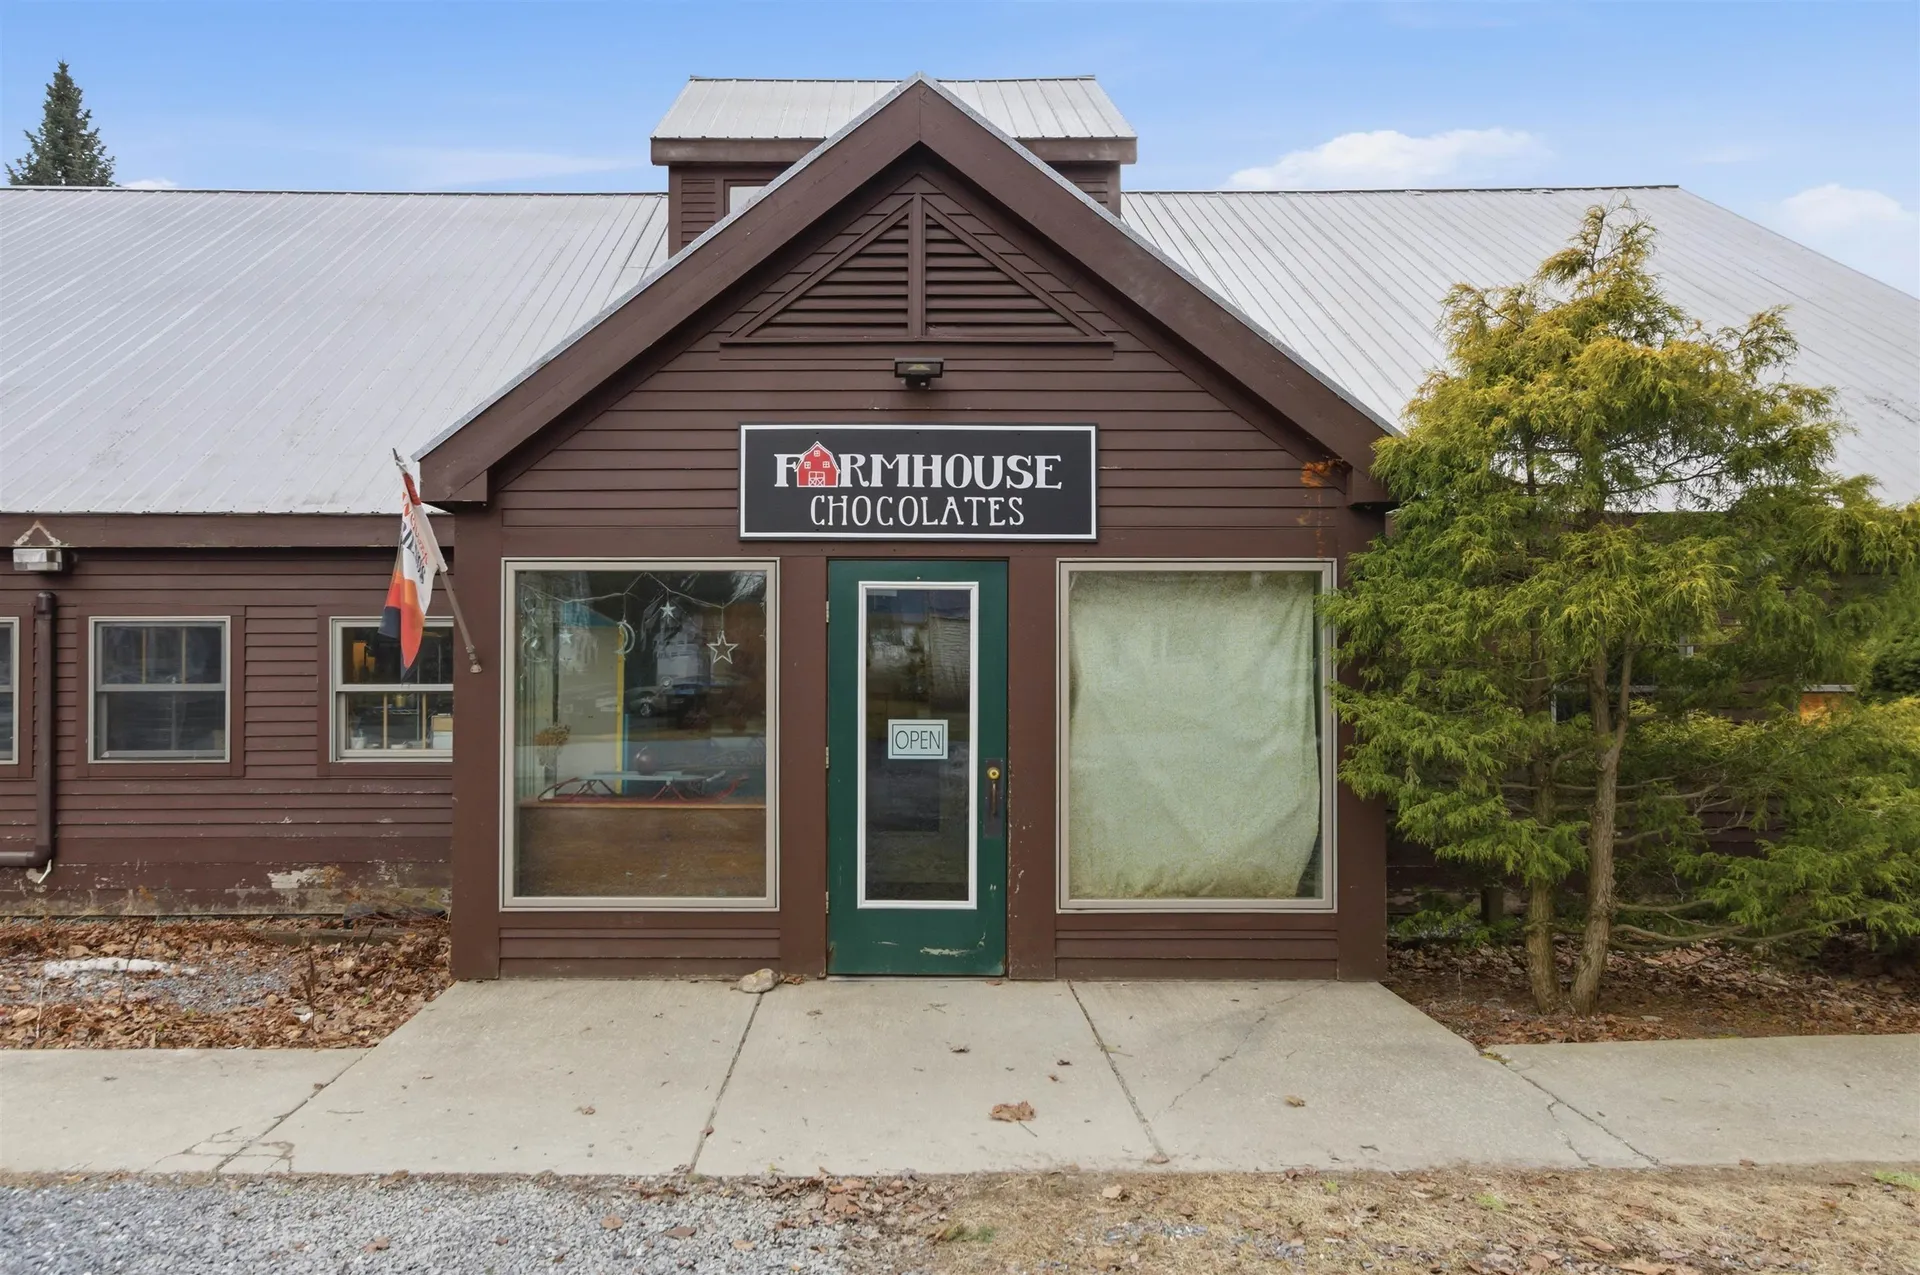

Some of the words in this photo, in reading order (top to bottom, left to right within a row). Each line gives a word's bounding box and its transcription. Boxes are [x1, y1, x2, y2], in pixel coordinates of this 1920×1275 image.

[774, 441, 1062, 490] FRMHOUSE
[810, 495, 1025, 527] CHOCOLATES
[895, 730, 941, 750] OPEN
